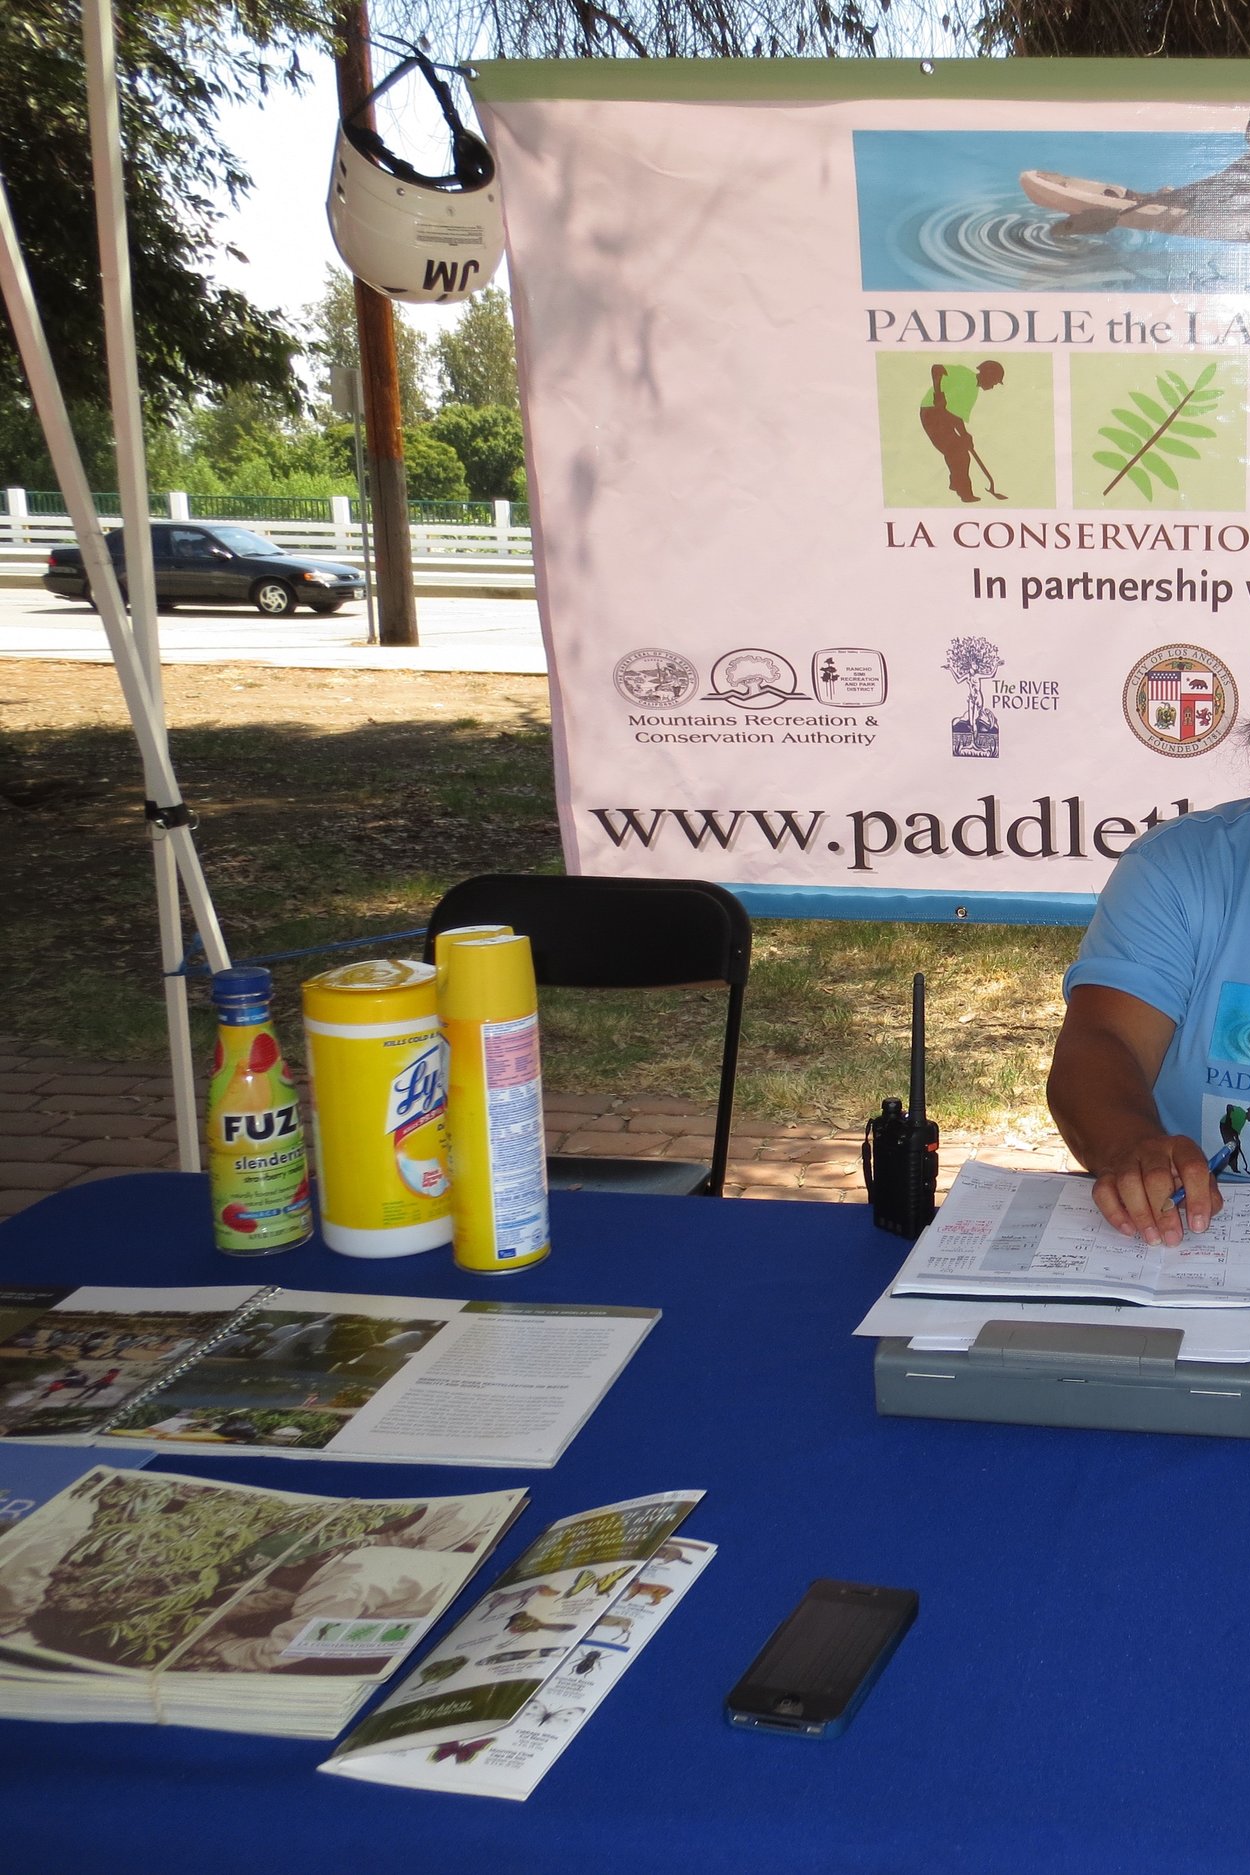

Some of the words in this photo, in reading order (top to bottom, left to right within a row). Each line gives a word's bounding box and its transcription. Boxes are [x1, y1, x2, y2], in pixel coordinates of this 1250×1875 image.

[423, 259, 480, 292] JM
[864, 308, 1094, 344] PADDLE
[1107, 316, 1171, 345] the
[884, 521, 936, 549] LA
[973, 567, 1006, 599] In
[1021, 568, 1232, 612] partnership
[1131, 663, 1149, 687] CITY
[1150, 653, 1164, 665] OF
[1168, 648, 1189, 657] LOS
[1192, 651, 1231, 687] ANGELES
[992, 679, 1016, 695] The
[1019, 680, 1060, 696] RIVER
[992, 695, 1060, 711] PROJECT
[628, 714, 737, 727] Mountains
[744, 714, 857, 727] Recreation
[865, 716, 879, 727] &
[635, 731, 774, 744] Conservation
[781, 731, 877, 746] Authority
[1147, 734, 1200, 752] FOUNDED
[1202, 729, 1223, 747] 1781
[224, 1104, 298, 1142] FUZ
